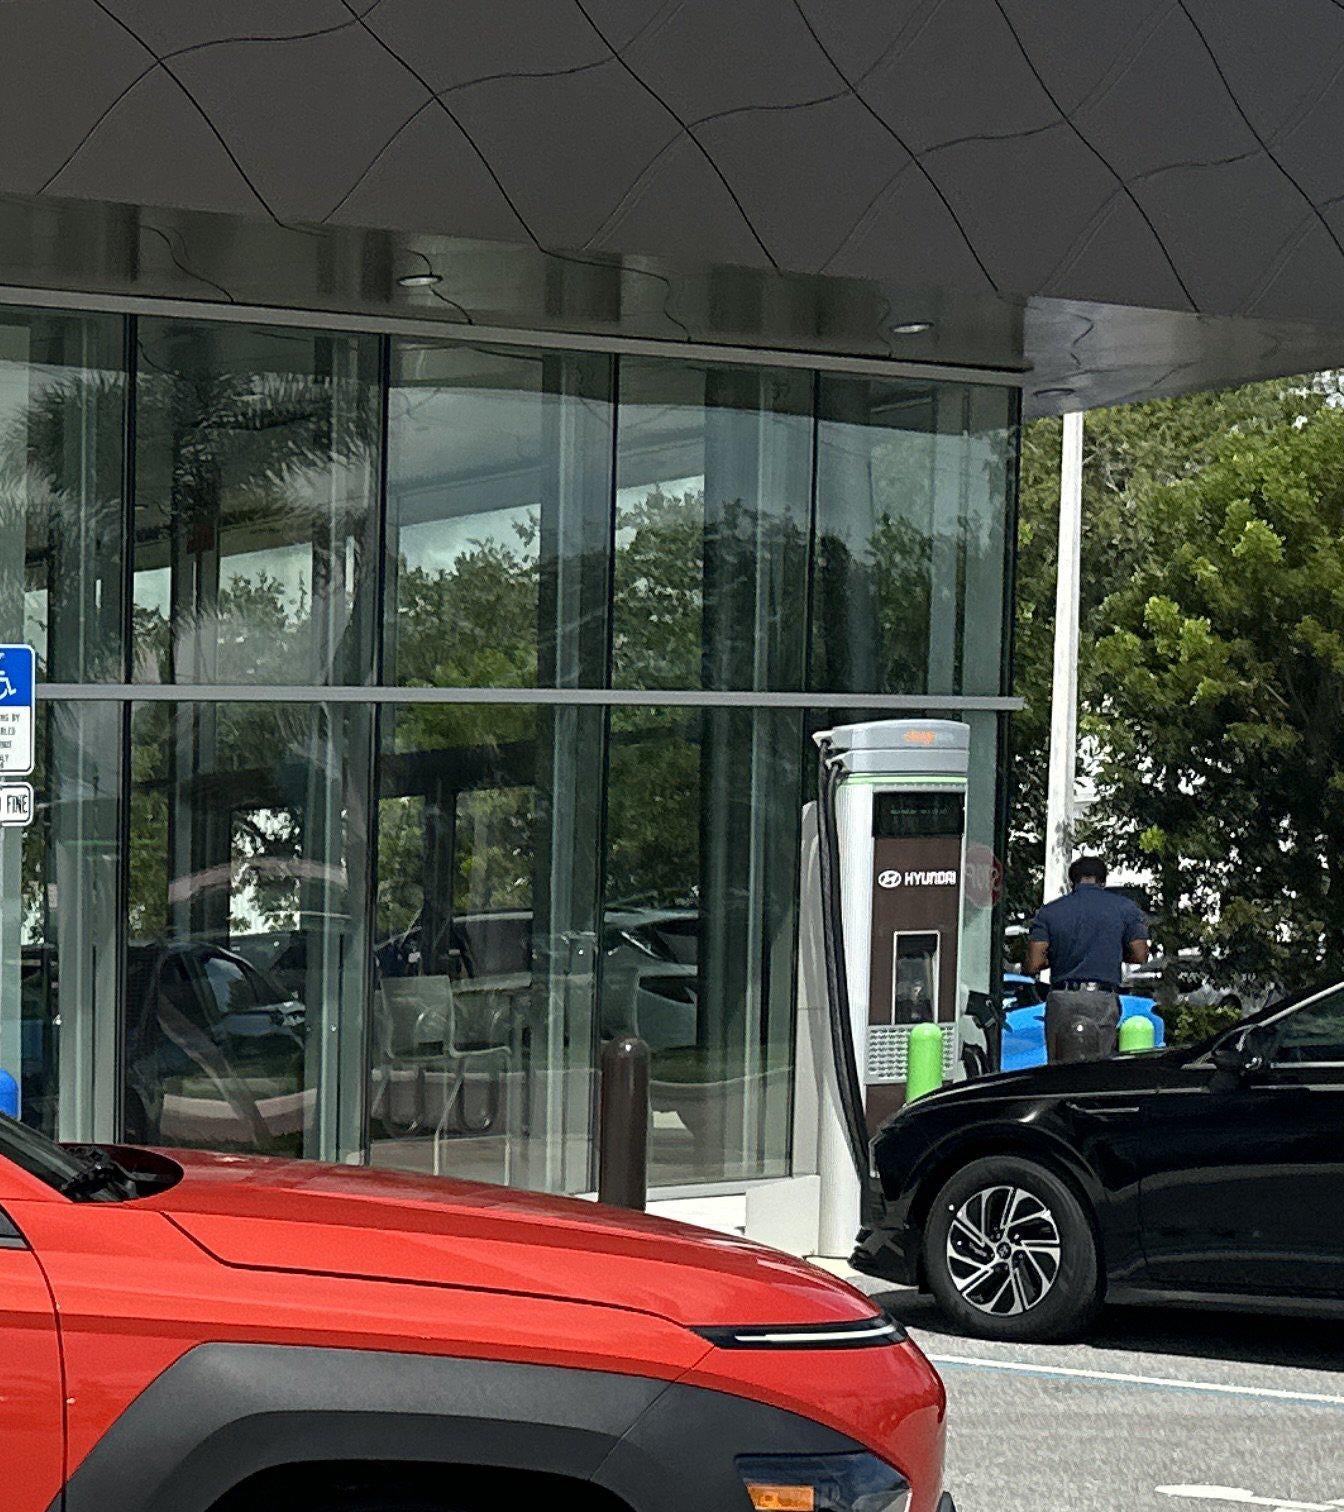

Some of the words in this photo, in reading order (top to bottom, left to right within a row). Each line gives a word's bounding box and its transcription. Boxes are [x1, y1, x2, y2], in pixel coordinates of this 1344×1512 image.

[12, 713, 20, 722] BY
[6, 794, 29, 815] FINE
[904, 871, 957, 886] HYUNDAI
